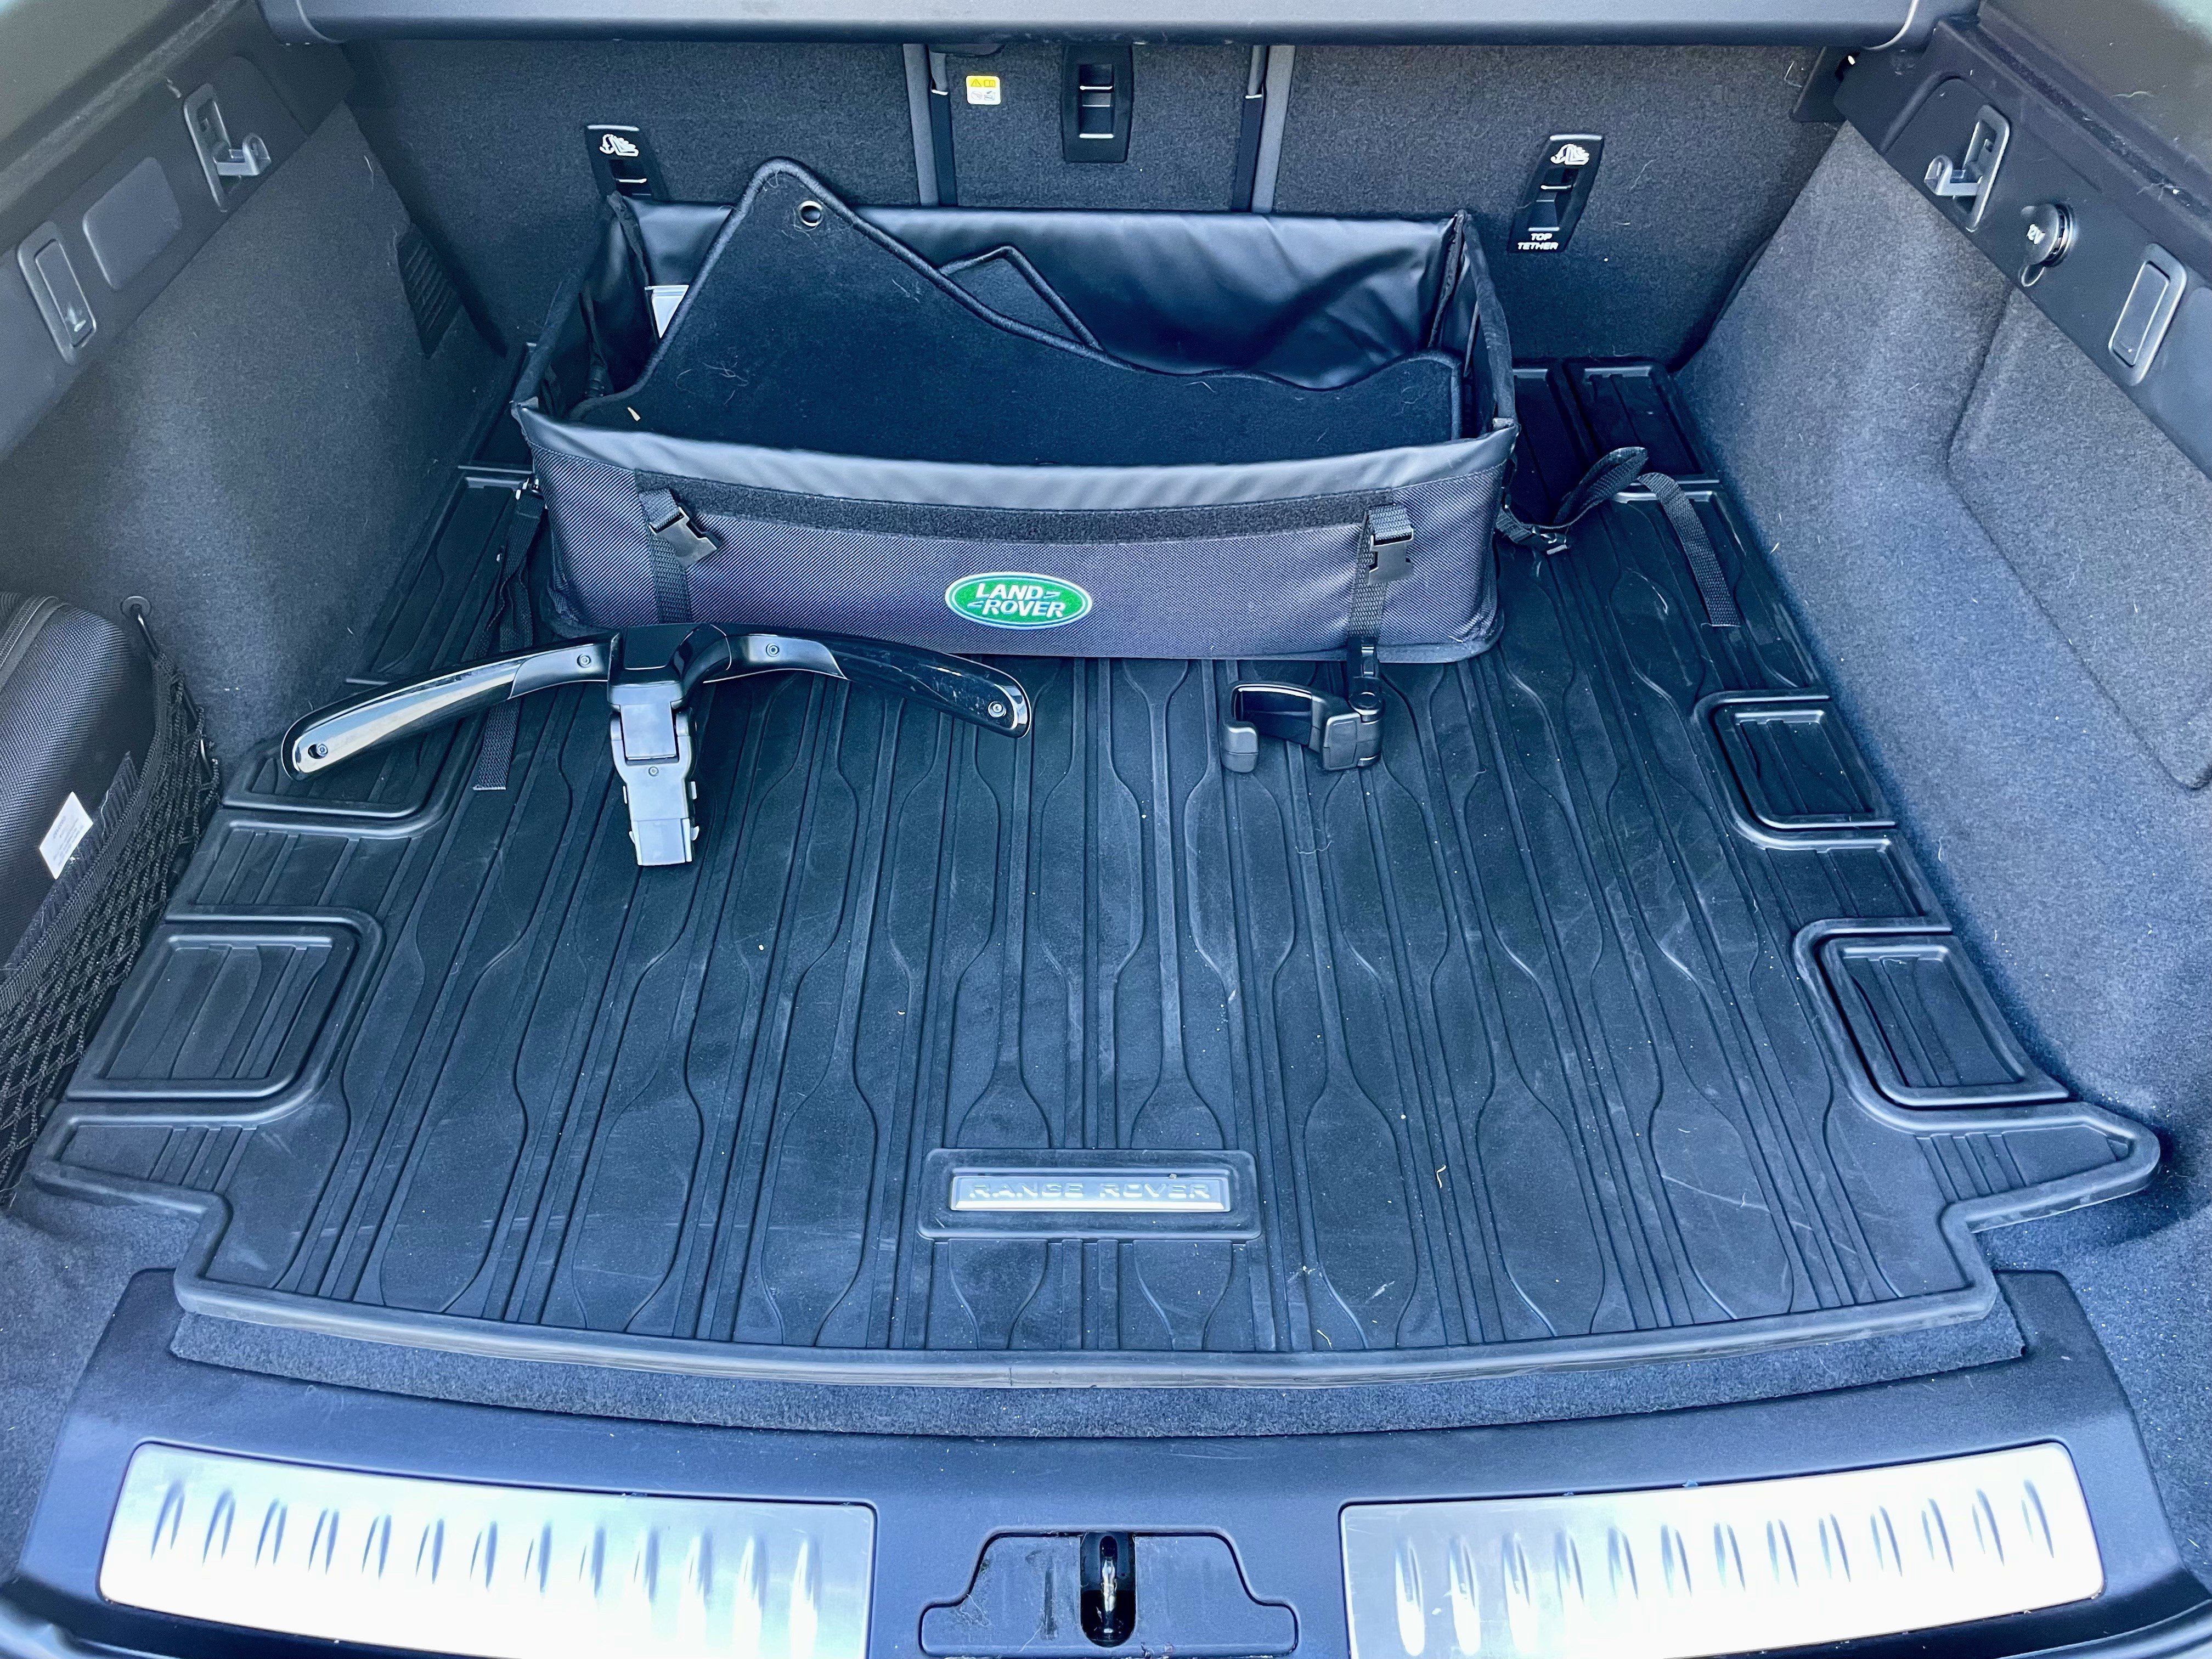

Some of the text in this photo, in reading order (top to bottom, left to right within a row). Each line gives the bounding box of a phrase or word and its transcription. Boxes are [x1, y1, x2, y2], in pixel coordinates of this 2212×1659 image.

[2027, 224, 2045, 245] 12V
[976, 583, 1042, 600] LAND
[981, 600, 1066, 618] ROVER
[969, 1182, 1210, 1199] RANGE ROVER
